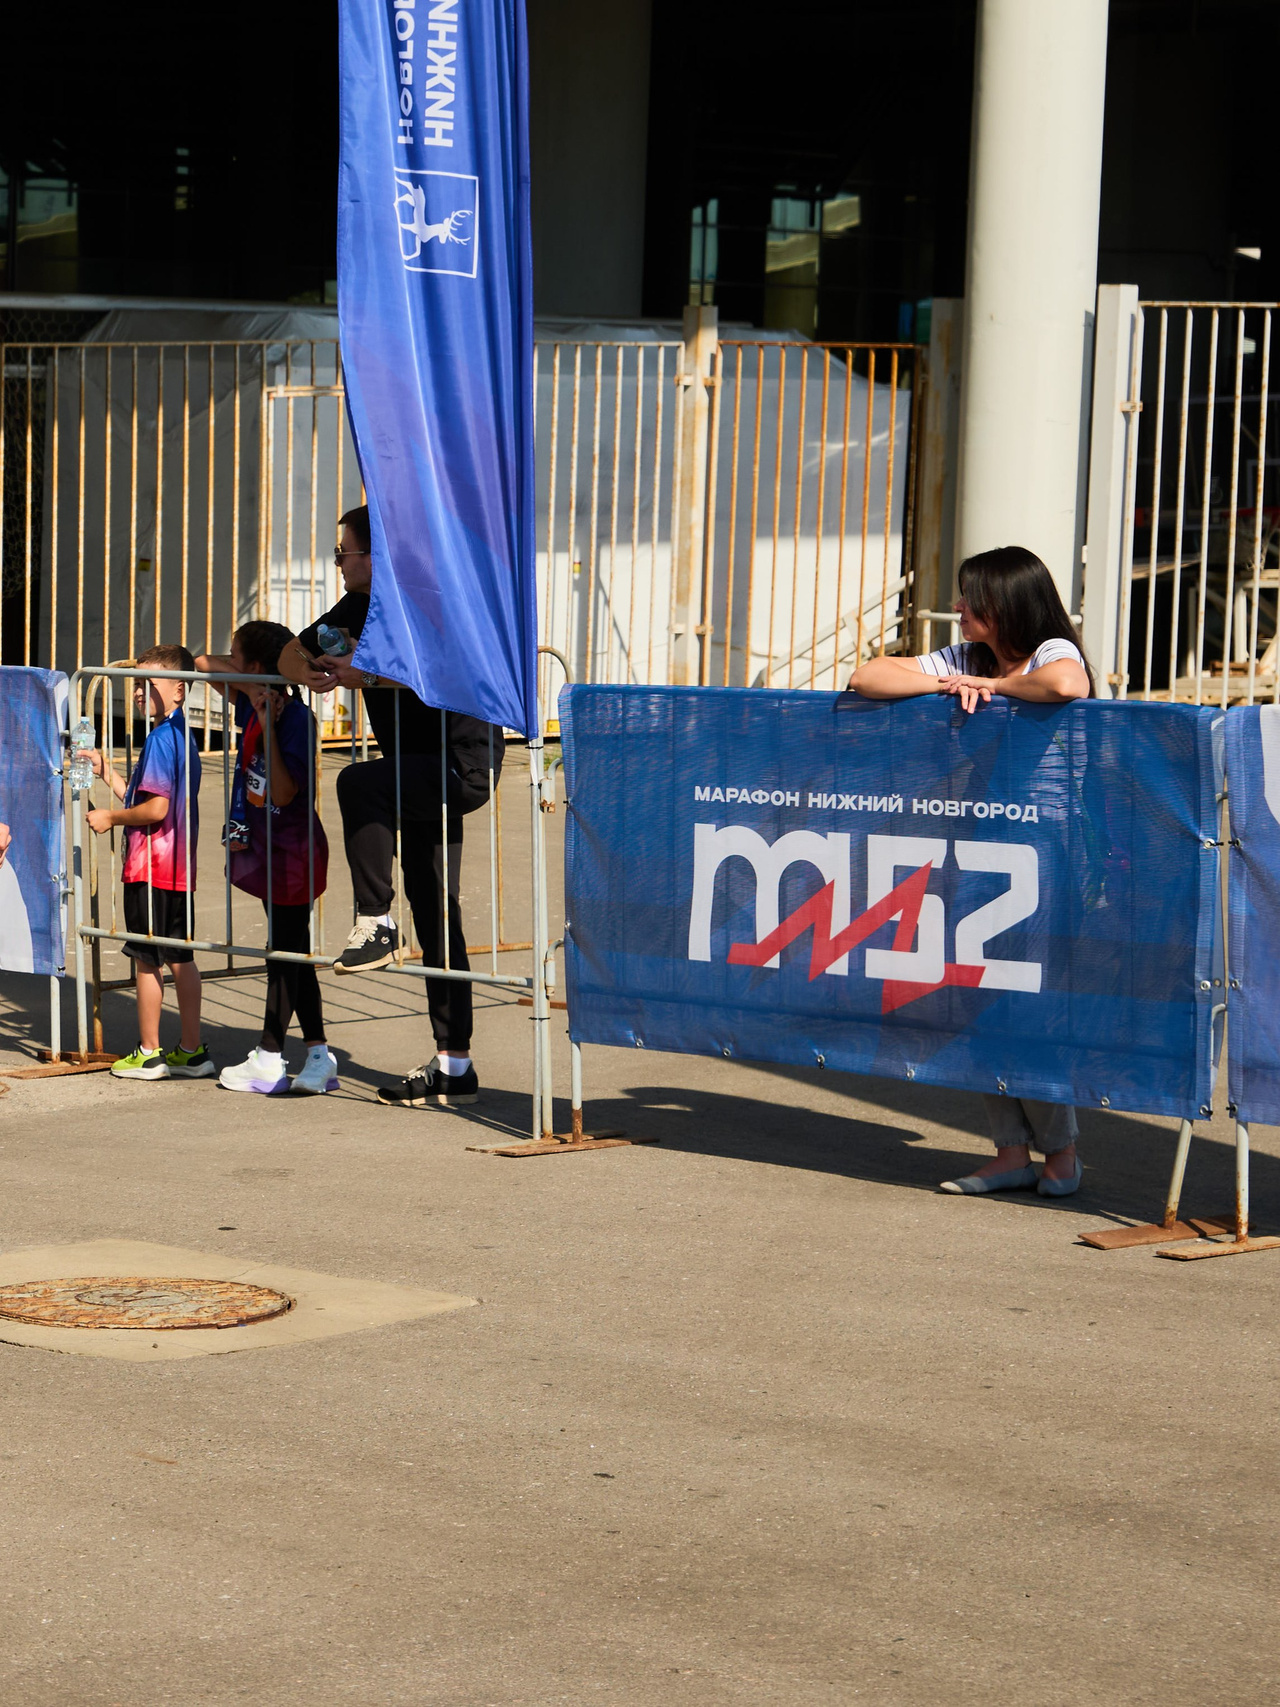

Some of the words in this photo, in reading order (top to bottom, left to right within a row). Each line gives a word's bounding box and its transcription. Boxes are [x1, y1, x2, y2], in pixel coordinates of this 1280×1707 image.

[694, 785, 800, 808] МАРАФОН
[808, 792, 904, 814] НИЖНИЙ
[912, 798, 1040, 824] НОВГОРОД
